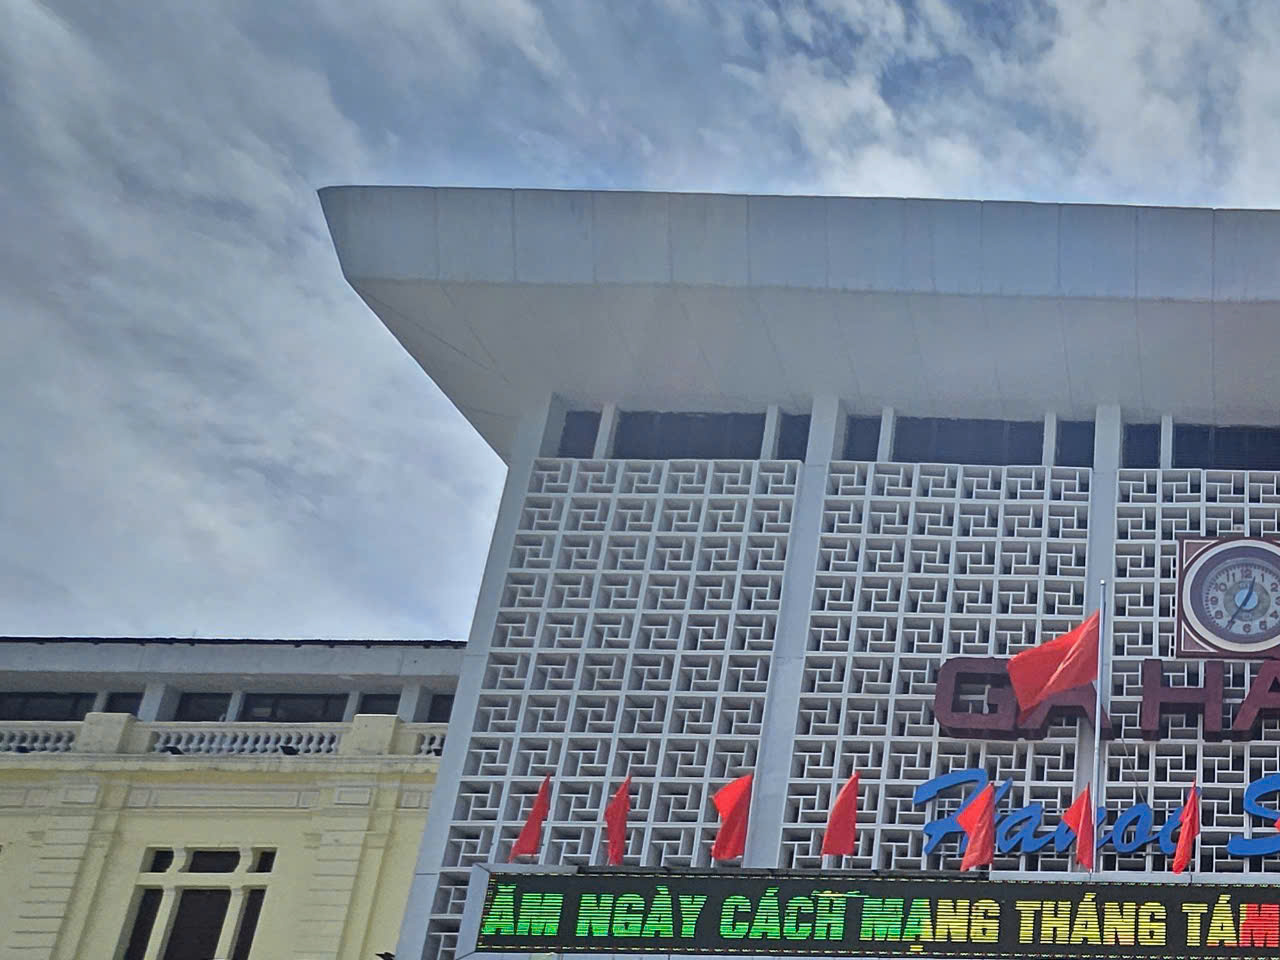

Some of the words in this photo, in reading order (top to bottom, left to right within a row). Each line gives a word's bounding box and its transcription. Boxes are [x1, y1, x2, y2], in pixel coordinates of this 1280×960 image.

[935, 657, 1115, 739] GA
[575, 884, 708, 938] NGÀY
[719, 887, 847, 941] CÁCH
[859, 897, 1000, 951] MẠNG
[1015, 892, 1167, 946] THÁNG
[1182, 894, 1280, 948] TÁM
